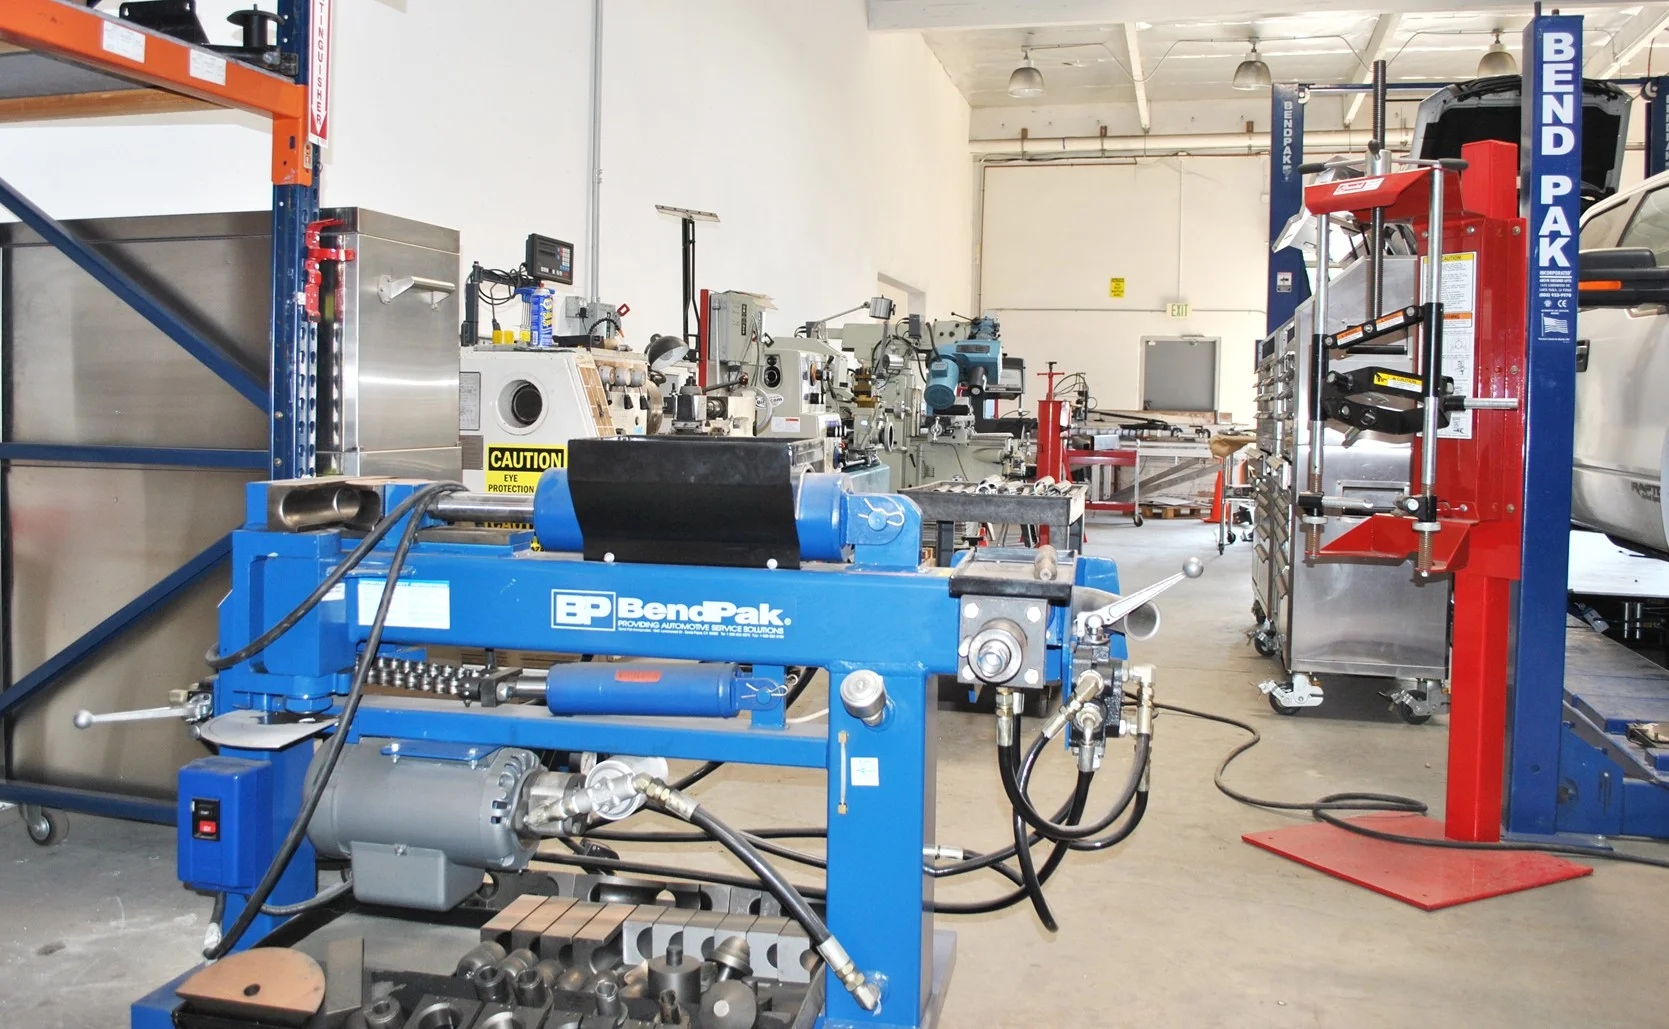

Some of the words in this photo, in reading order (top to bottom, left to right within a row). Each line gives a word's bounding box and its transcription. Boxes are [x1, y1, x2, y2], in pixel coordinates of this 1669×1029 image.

[1541, 32, 1575, 155] BEND
[1282, 101, 1293, 164] BENDPAK
[1538, 175, 1573, 267] PAK
[1171, 304, 1188, 317] EXIT
[490, 451, 562, 469] CAUTION
[504, 474, 518, 482] EYE
[488, 484, 534, 493] PROTECTION
[556, 594, 612, 625] BP
[618, 620, 660, 629] PROVIDING
[661, 622, 710, 632] AUTOMOTIVE
[711, 624, 742, 633] SERVICE
[743, 626, 784, 634] SOLUTIONS
